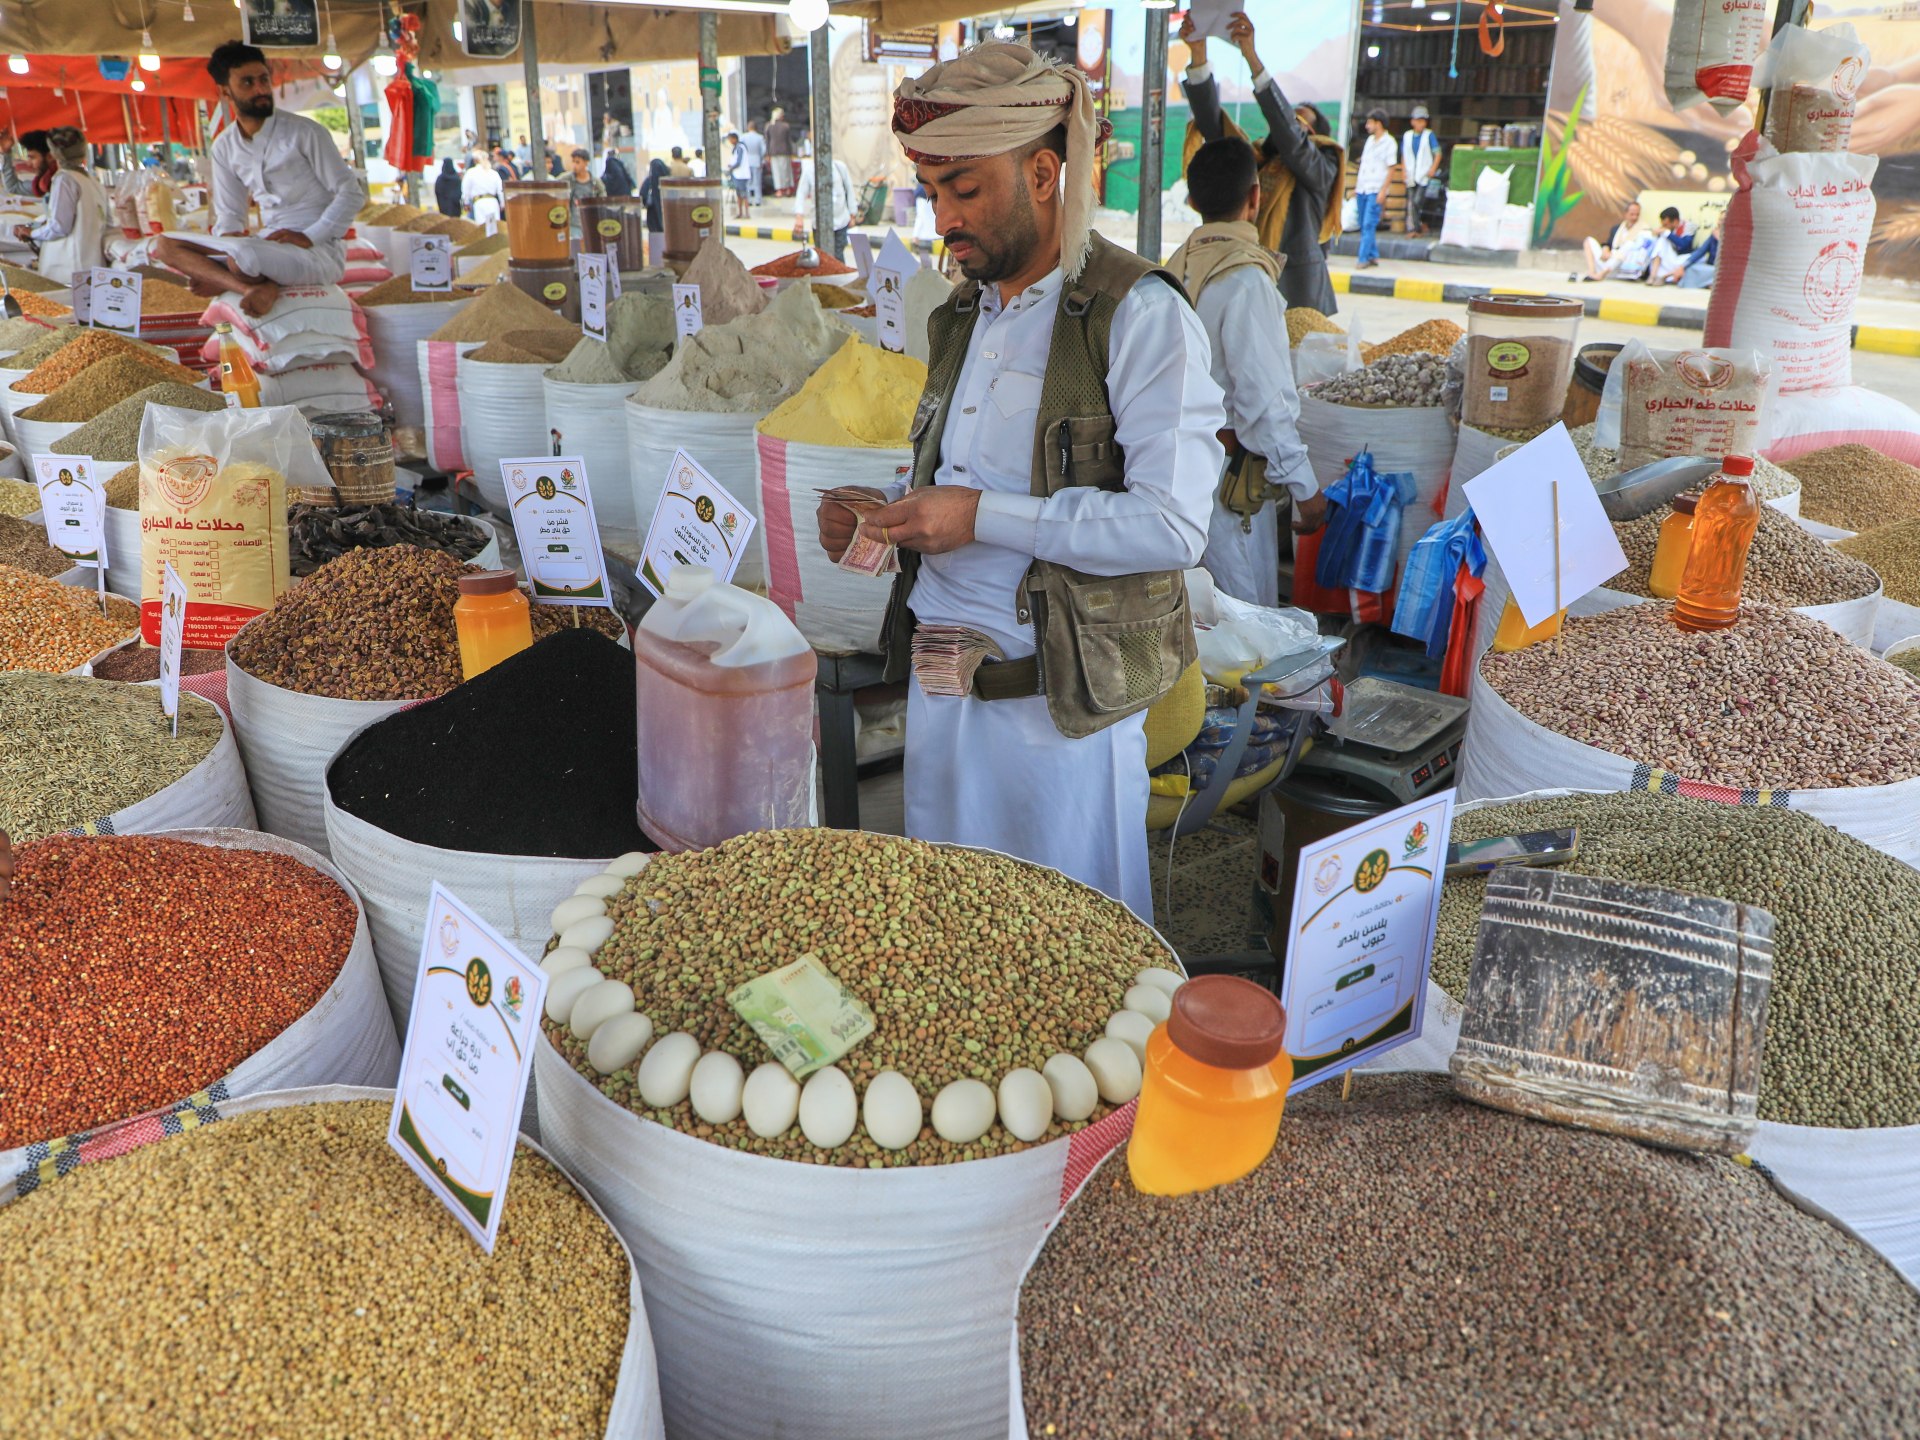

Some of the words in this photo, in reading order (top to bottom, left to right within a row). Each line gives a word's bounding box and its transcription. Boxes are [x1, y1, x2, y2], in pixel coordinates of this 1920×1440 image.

[1822, 180, 1837, 196] طه
[1645, 396, 1694, 414] الحباري
[1696, 398, 1716, 411] طه
[1720, 400, 1756, 412] محلات
[142, 516, 172, 533] الحباري
[174, 518, 194, 530] طه
[196, 518, 244, 531] محلات
[556, 518, 568, 526] قشر
[681, 526, 702, 546] السوداء
[691, 545, 699, 554] حق
[702, 544, 710, 555] حبة
[700, 553, 707, 562] من
[1337, 929, 1360, 948] بلدي
[1361, 932, 1386, 950] حبوب
[1348, 969, 1365, 984] السعر
[455, 1048, 466, 1062] حق
[470, 1041, 482, 1060] ذرة
[468, 1059, 479, 1075] من
